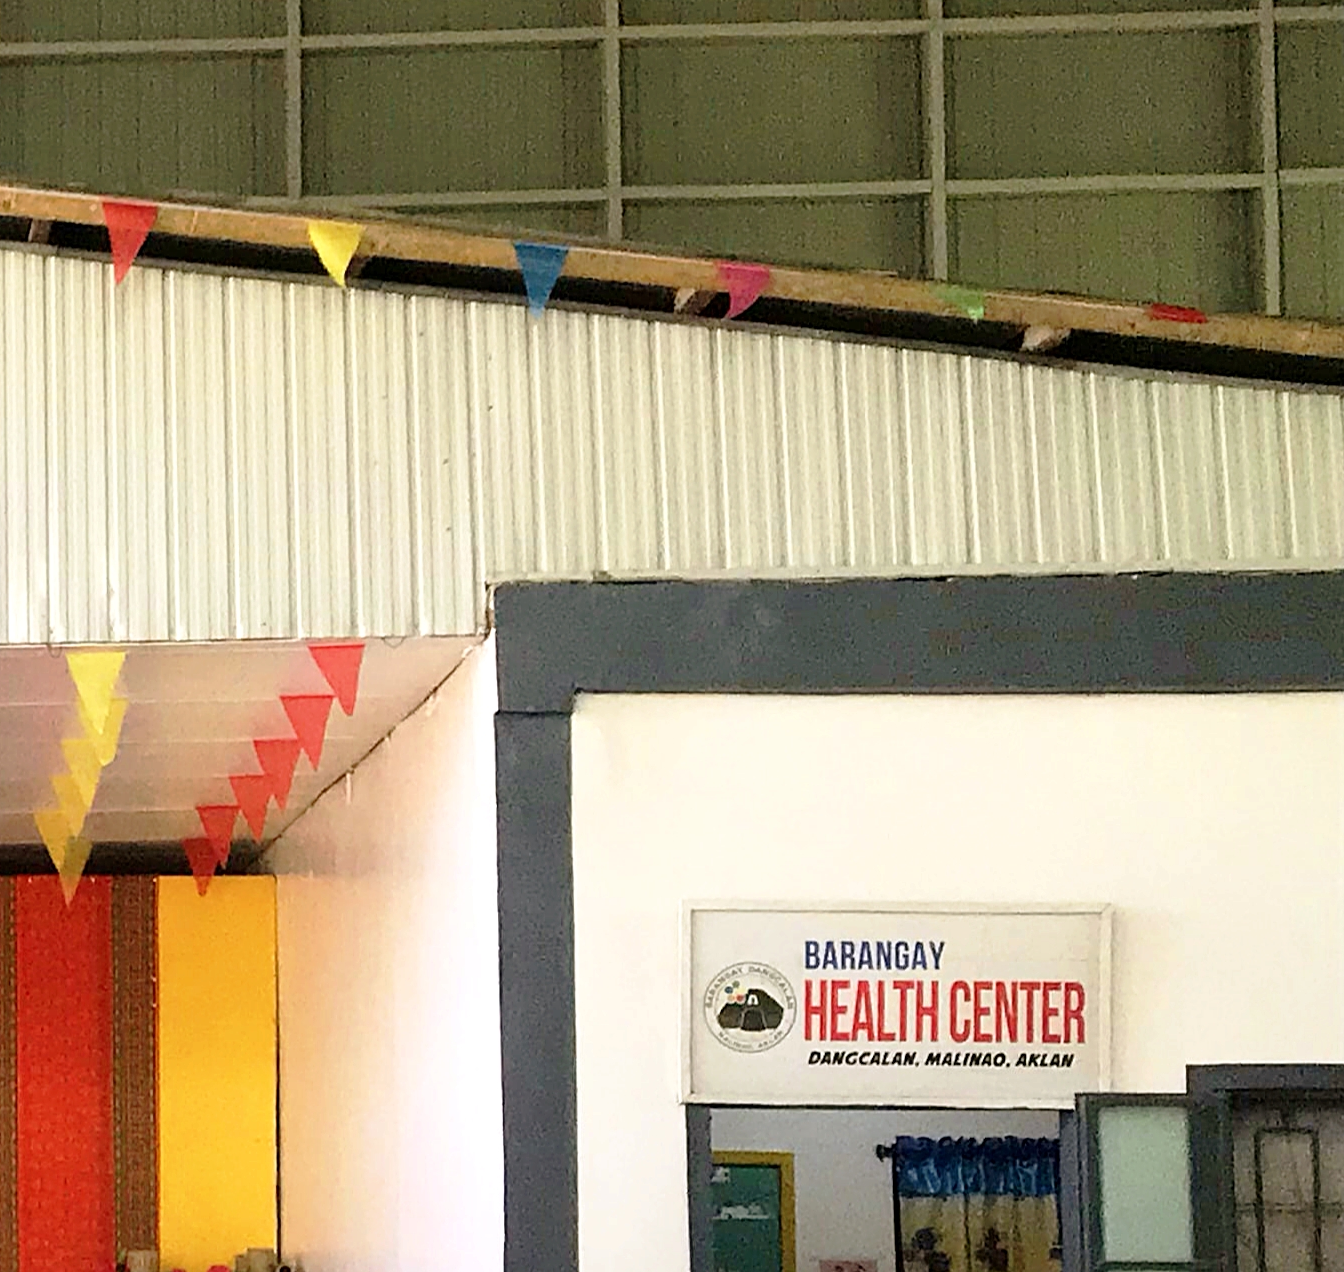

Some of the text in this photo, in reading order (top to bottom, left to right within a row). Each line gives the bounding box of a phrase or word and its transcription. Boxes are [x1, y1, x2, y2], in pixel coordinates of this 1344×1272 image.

[804, 940, 946, 970] BARANGAY
[804, 980, 1086, 1044] HEALTH CENTER
[808, 1051, 921, 1068] DANGCALAN,
[1015, 1053, 1074, 1068] AKLAN
